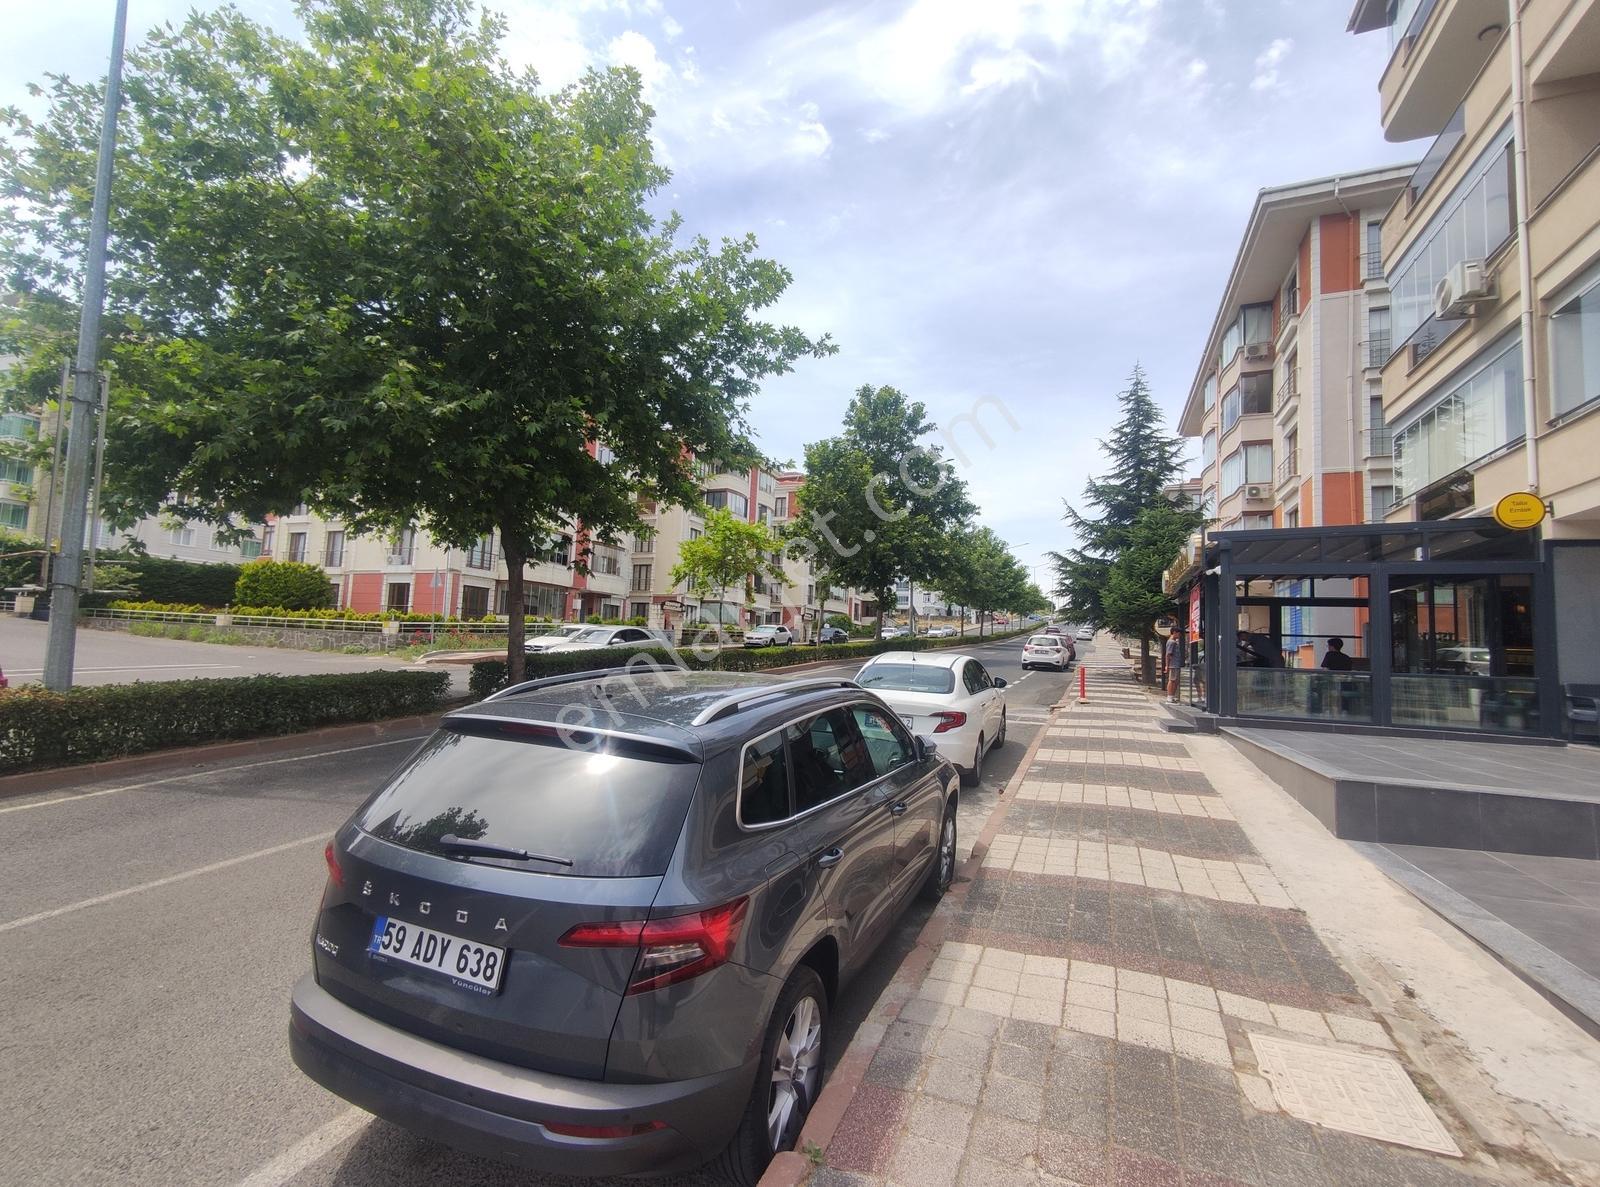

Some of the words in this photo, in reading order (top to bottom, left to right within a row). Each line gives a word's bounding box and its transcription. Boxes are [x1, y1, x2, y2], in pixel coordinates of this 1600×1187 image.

[374, 934, 382, 945] TR
[381, 922, 407, 954] 59
[410, 931, 452, 968] ADY
[456, 944, 498, 982] 638
